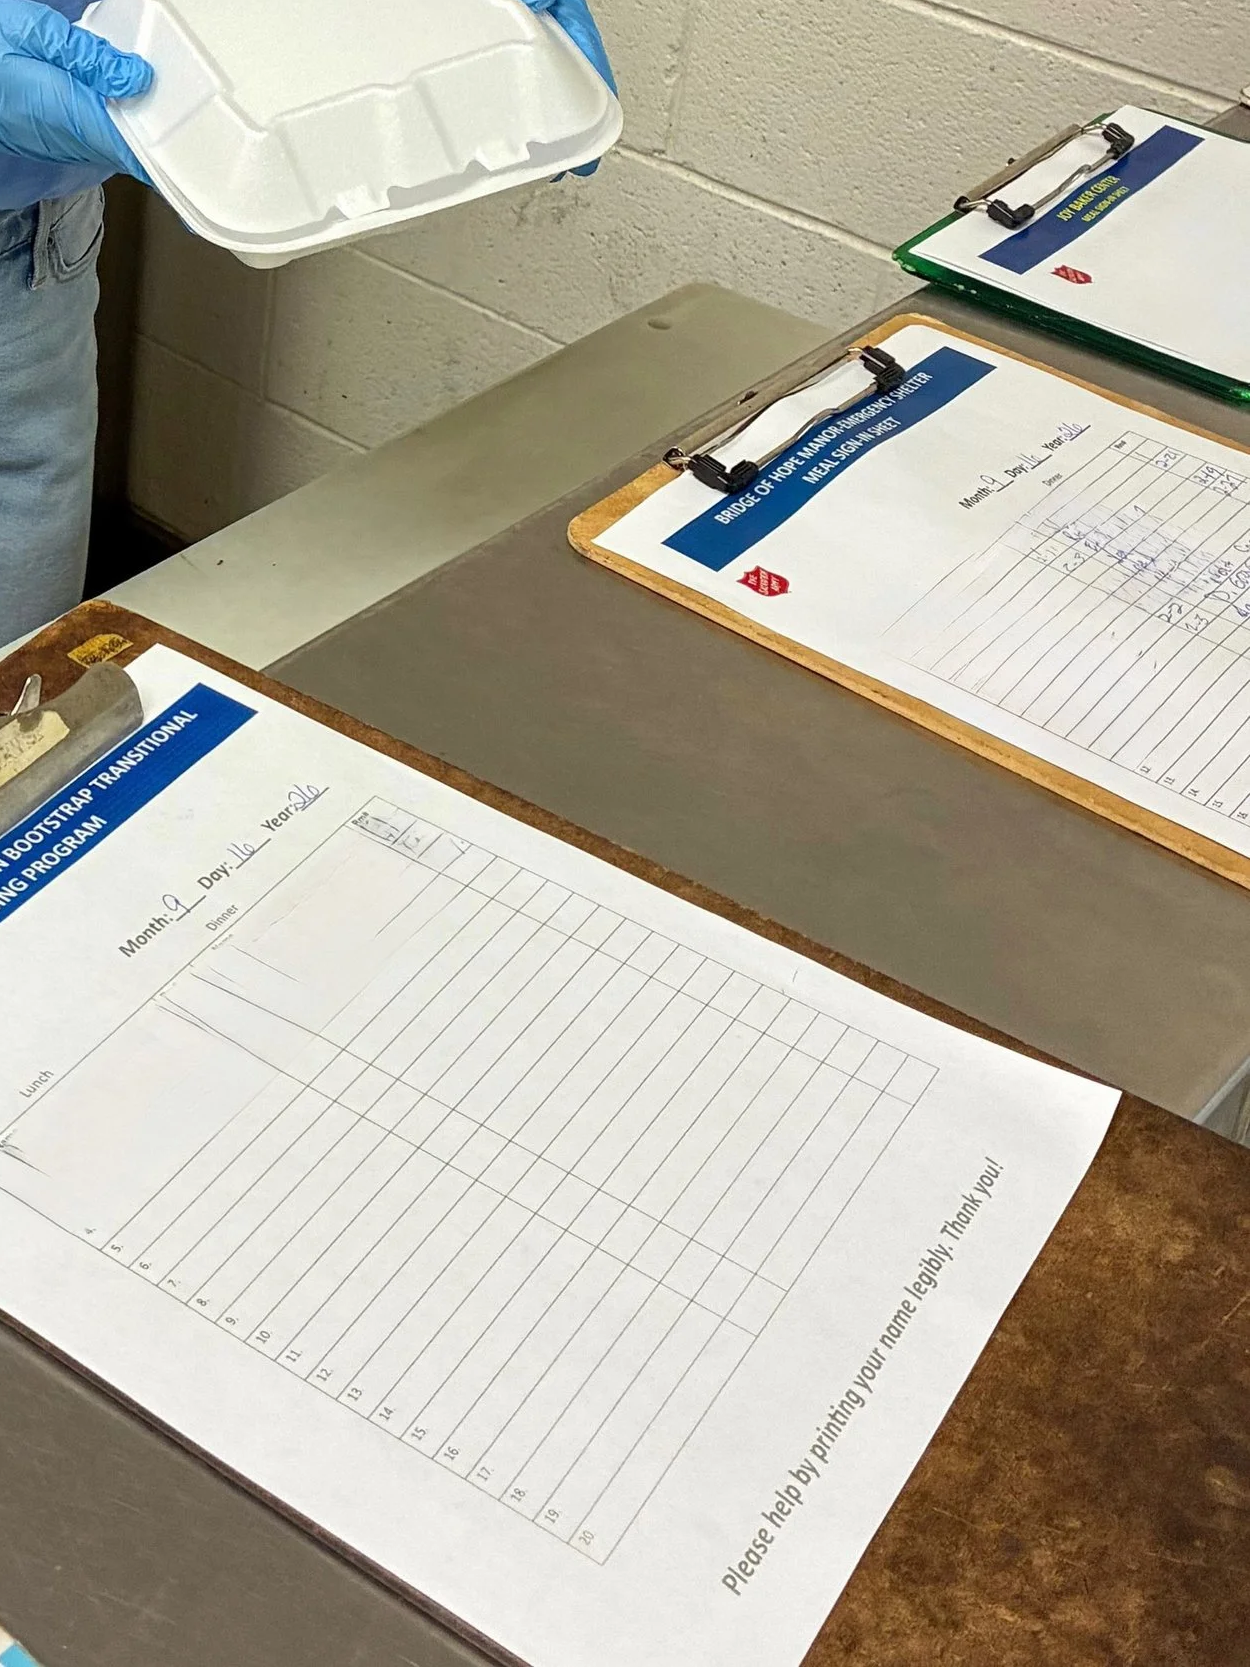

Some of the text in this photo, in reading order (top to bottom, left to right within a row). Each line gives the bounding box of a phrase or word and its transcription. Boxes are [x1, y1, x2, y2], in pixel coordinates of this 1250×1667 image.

[714, 371, 933, 525] BRIDGE OF HOPE MANOR-EMERGENCY SHELTER
[801, 415, 902, 485] MEAL SIGN-IN SHEET
[1041, 435, 1069, 452] Year:
[1004, 462, 1031, 479] Day:
[958, 485, 995, 510] Month:
[2, 788, 94, 861] BOOTSTRAP
[88, 709, 198, 790] TRANSITIONAL
[260, 803, 299, 832] Year:
[21, 814, 107, 882] PROGRAM
[197, 861, 233, 890] Day:
[205, 903, 239, 932] Dinner
[118, 913, 175, 958] Month:
[19, 1068, 54, 1098] Lunch
[721, 1156, 1005, 1597] Please help by printing your name legibly. Thank you!
